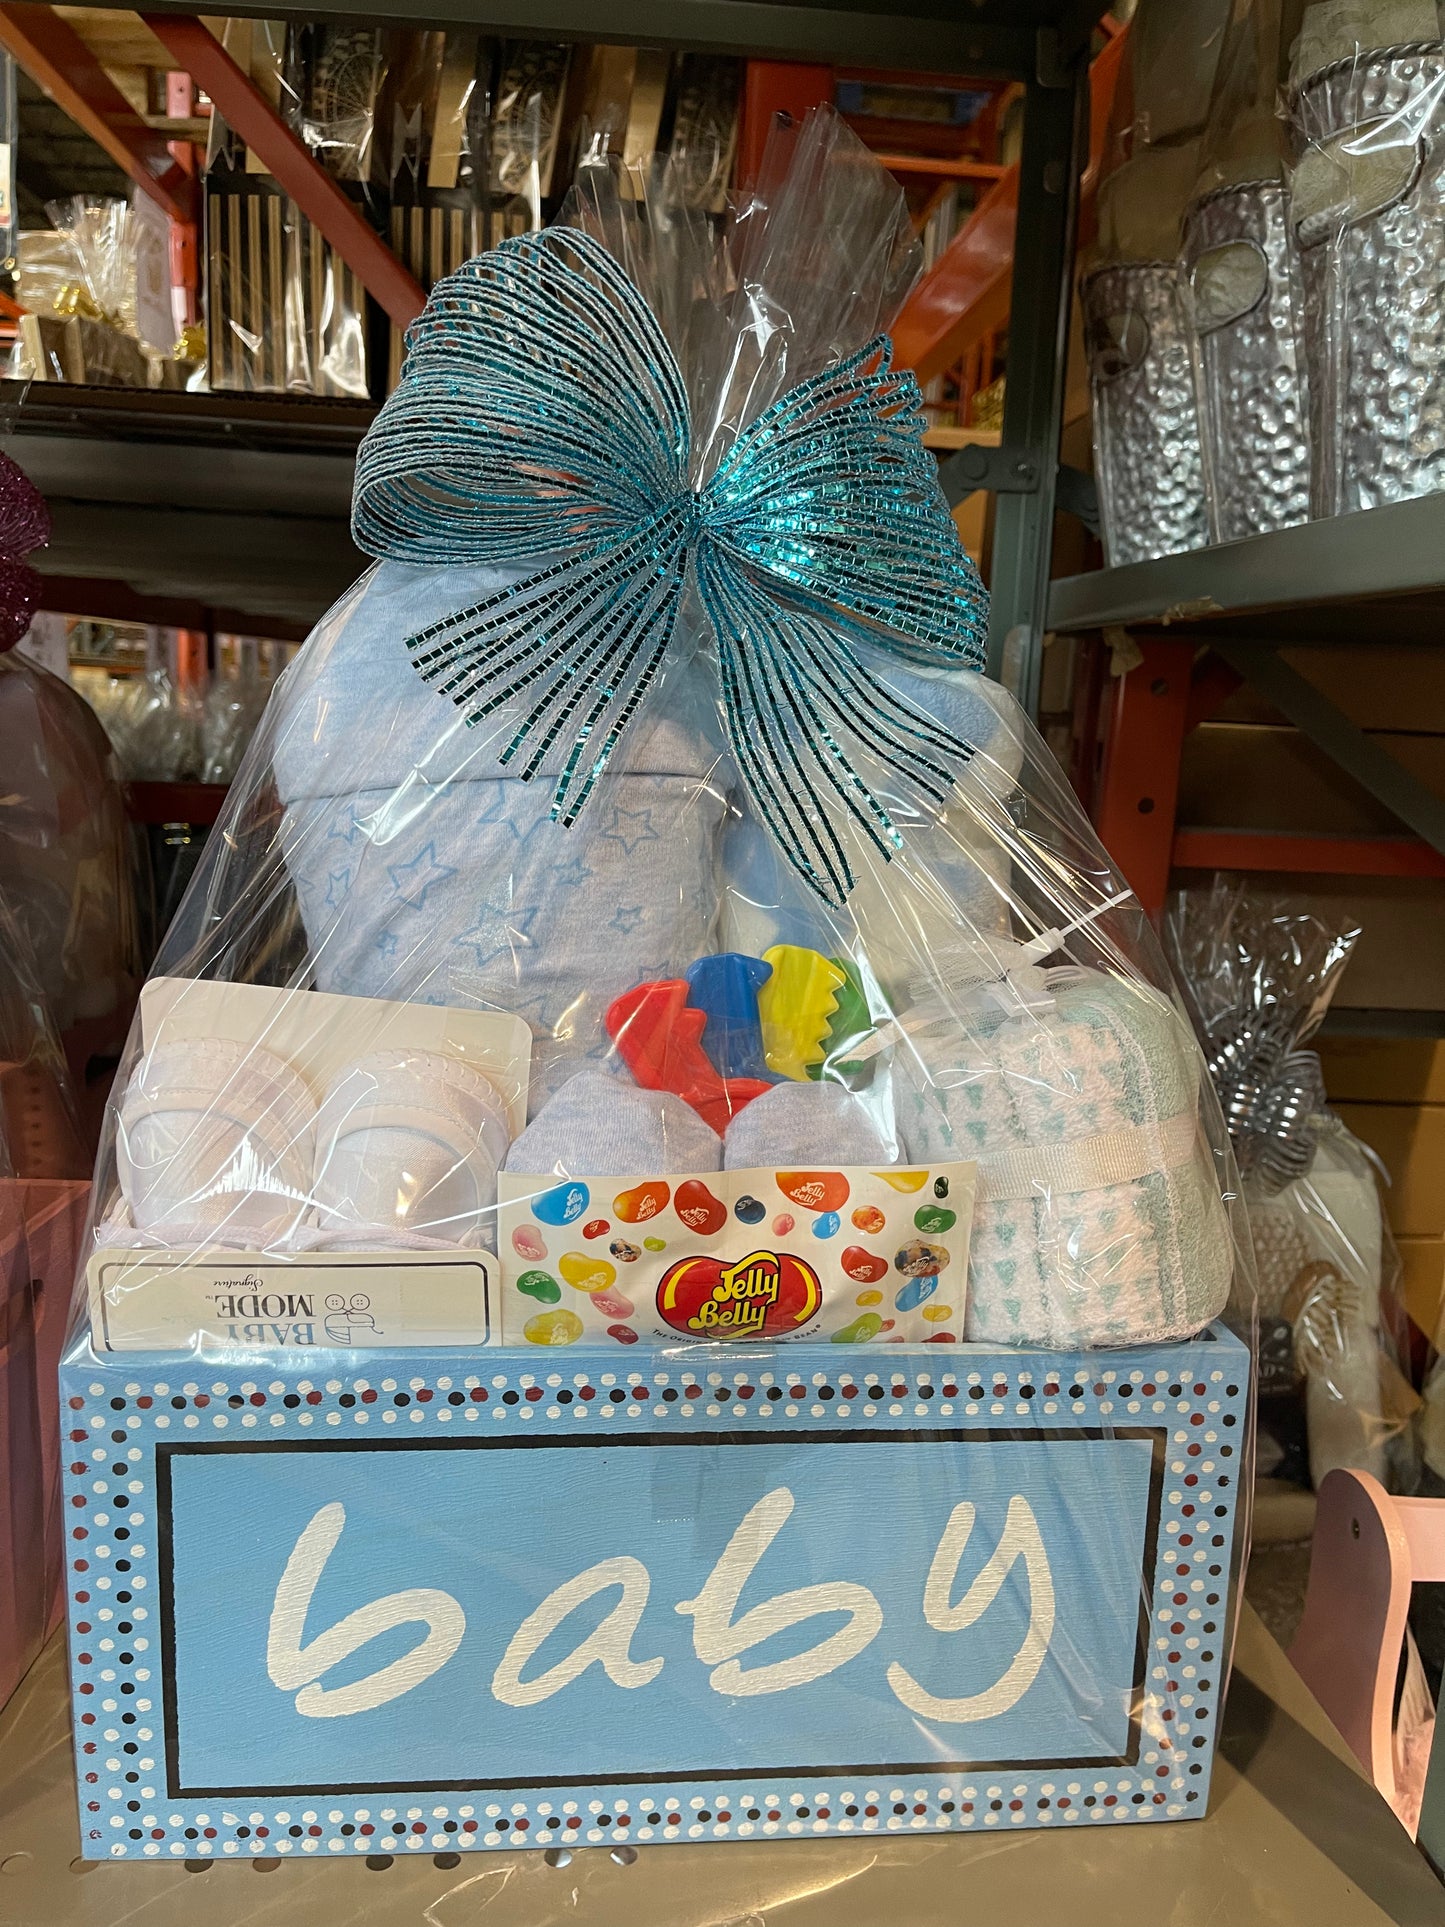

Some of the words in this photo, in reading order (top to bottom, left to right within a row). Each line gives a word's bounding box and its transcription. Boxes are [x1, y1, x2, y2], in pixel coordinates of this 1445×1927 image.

[790, 1188, 816, 1206] Belly
[800, 1181, 825, 1201] Jelly
[213, 1273, 264, 1291] Signature
[712, 1250, 780, 1306] Jelly
[687, 1300, 767, 1340] Belly
[267, 1487, 1056, 1723] baby
